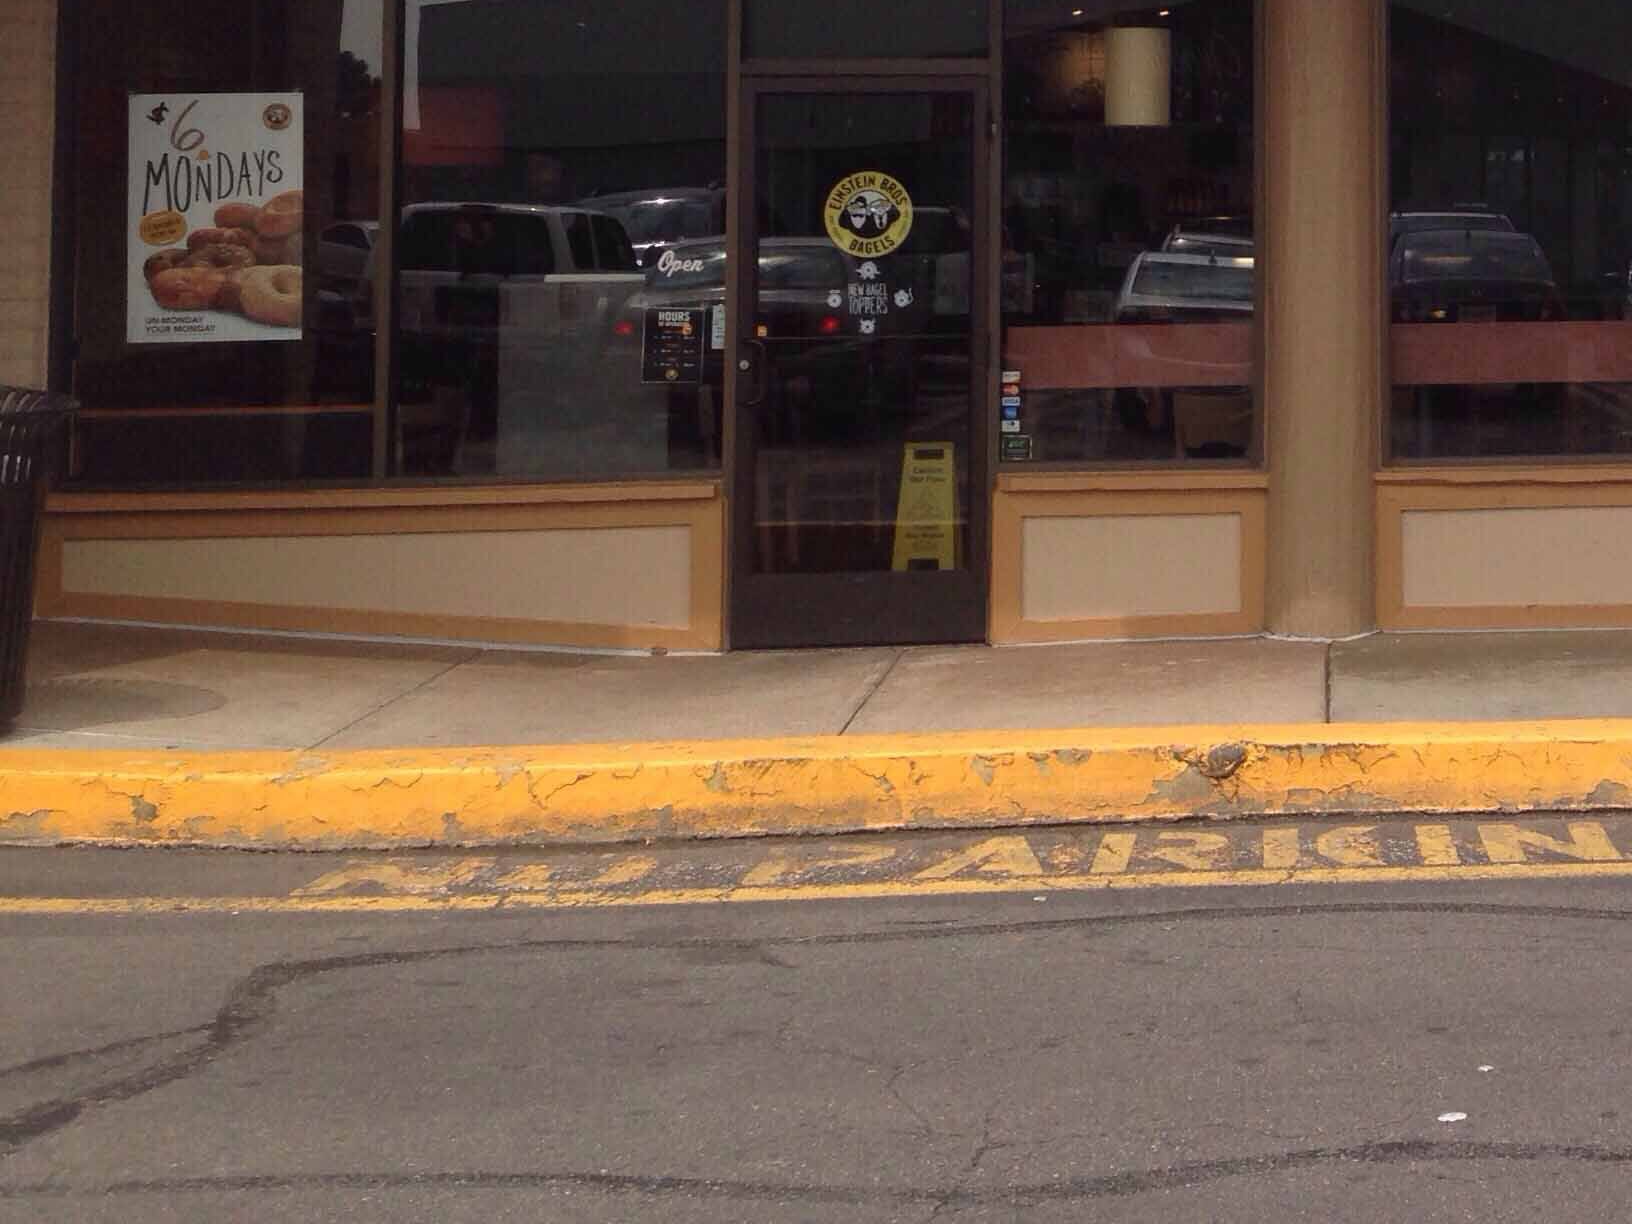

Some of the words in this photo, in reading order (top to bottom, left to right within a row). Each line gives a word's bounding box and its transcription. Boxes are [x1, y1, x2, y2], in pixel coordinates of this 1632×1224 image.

[143, 150, 284, 216] MONDAYS
[829, 175, 876, 210] EINSTEIN
[848, 235, 895, 254] BAGELS
[657, 250, 704, 278] Open
[658, 311, 690, 321] HOURS
